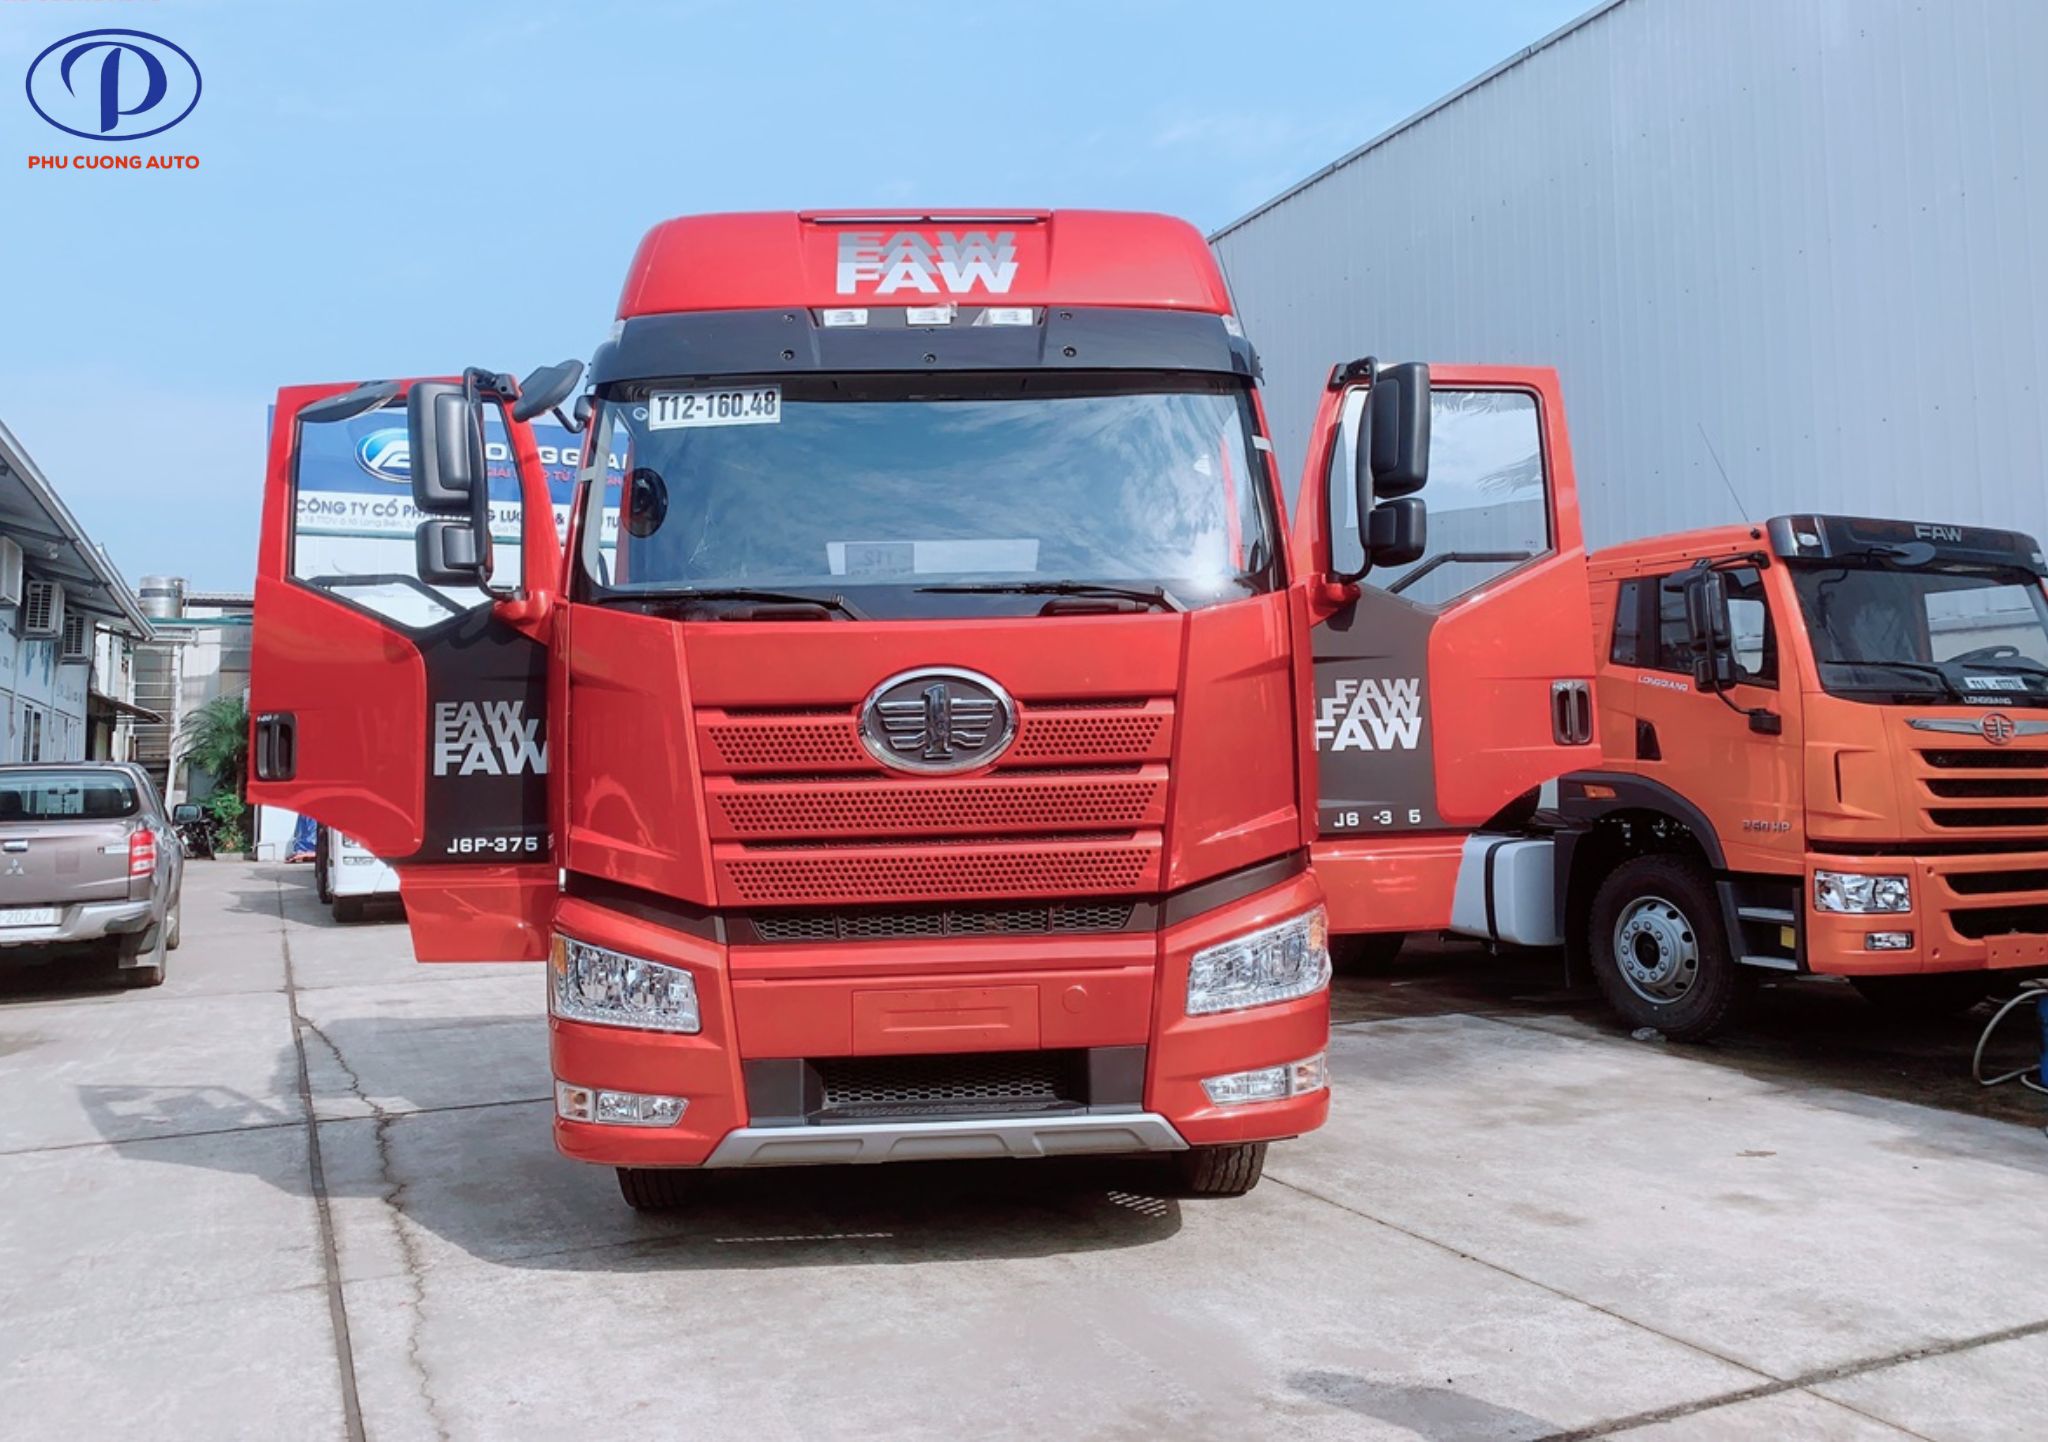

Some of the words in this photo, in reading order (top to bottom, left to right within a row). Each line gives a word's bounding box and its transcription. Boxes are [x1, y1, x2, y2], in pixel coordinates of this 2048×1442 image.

[836, 261, 1020, 294] FAW
[658, 391, 776, 422] T12-160.48
[351, 502, 369, 515] TY
[1914, 524, 1961, 542] FAW
[433, 741, 548, 776] FAW
[447, 837, 538, 853] J6P-375
